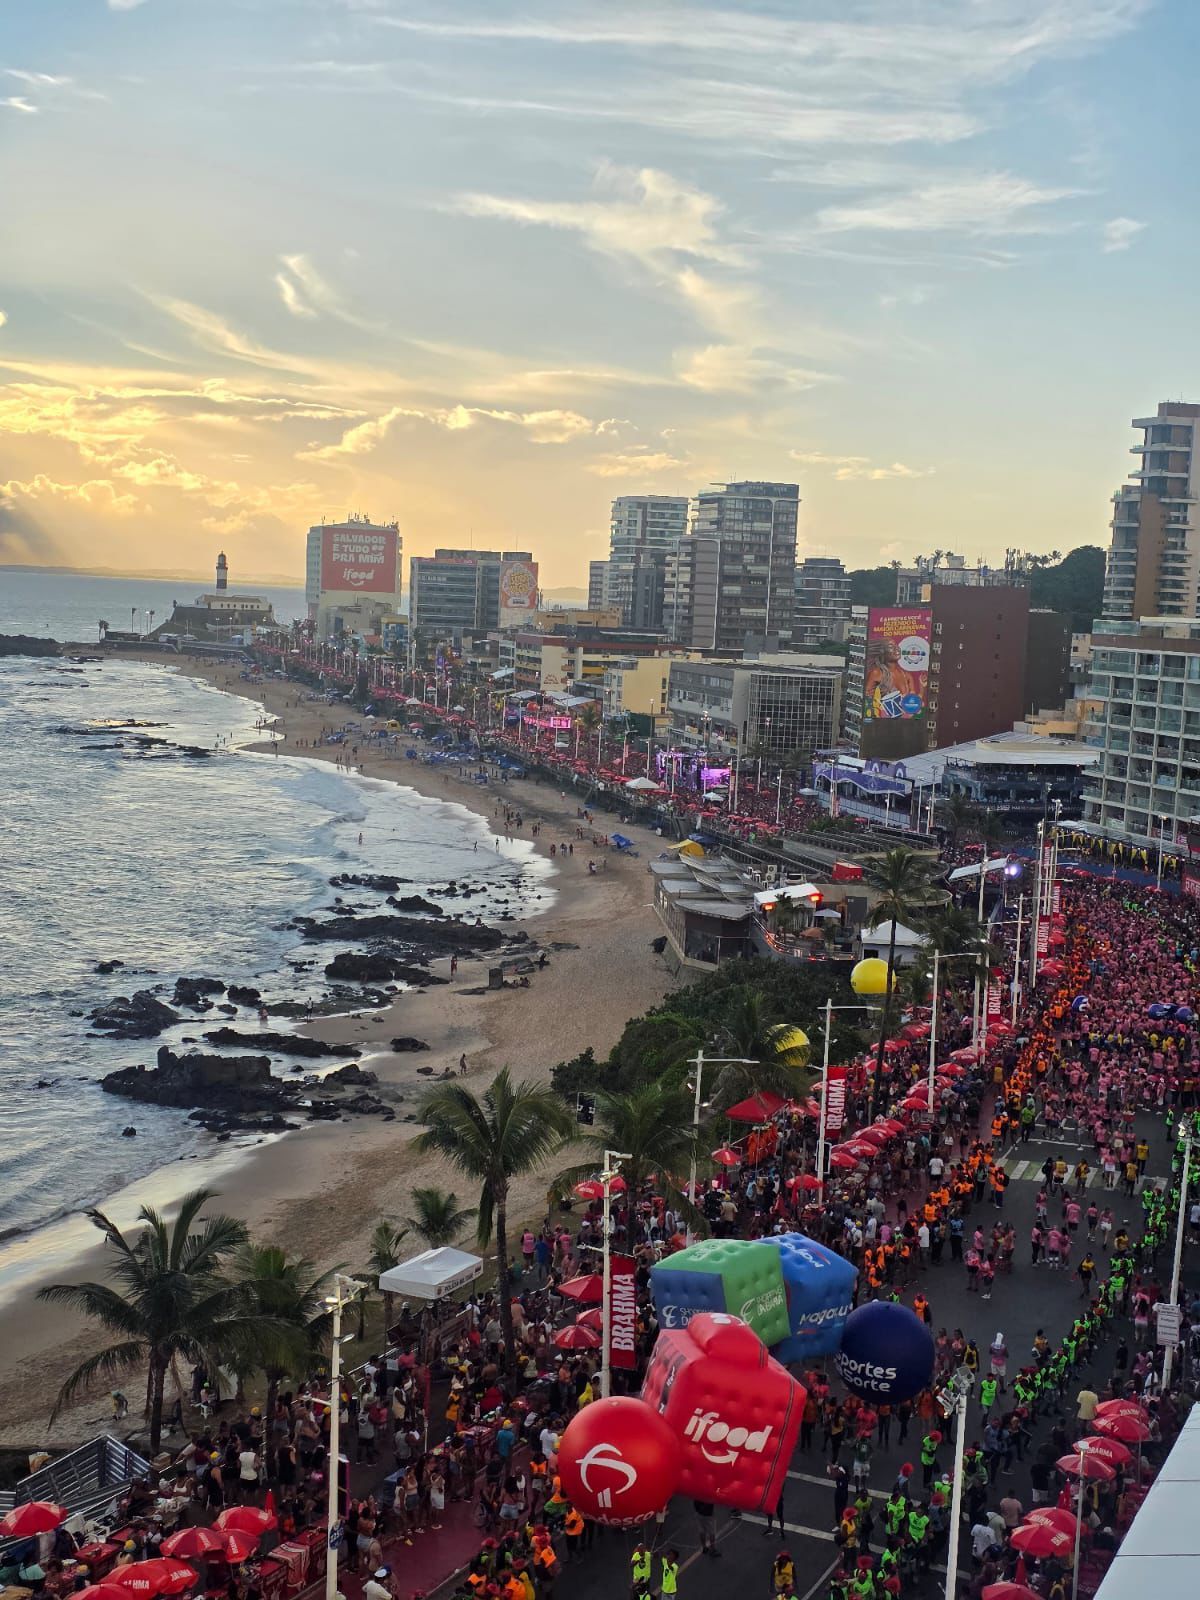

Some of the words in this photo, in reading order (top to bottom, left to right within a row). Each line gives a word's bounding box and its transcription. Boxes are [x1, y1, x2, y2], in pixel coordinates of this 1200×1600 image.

[333, 534, 386, 544] SALVADOR
[342, 544, 370, 553] TUDO
[332, 553, 355, 562] PRA
[358, 554, 384, 564] MIM
[343, 568, 374, 580] ifood
[826, 1079, 846, 1129] BRAHMA
[612, 1273, 635, 1351] BRAHMA
[684, 1408, 773, 1453] ifood
